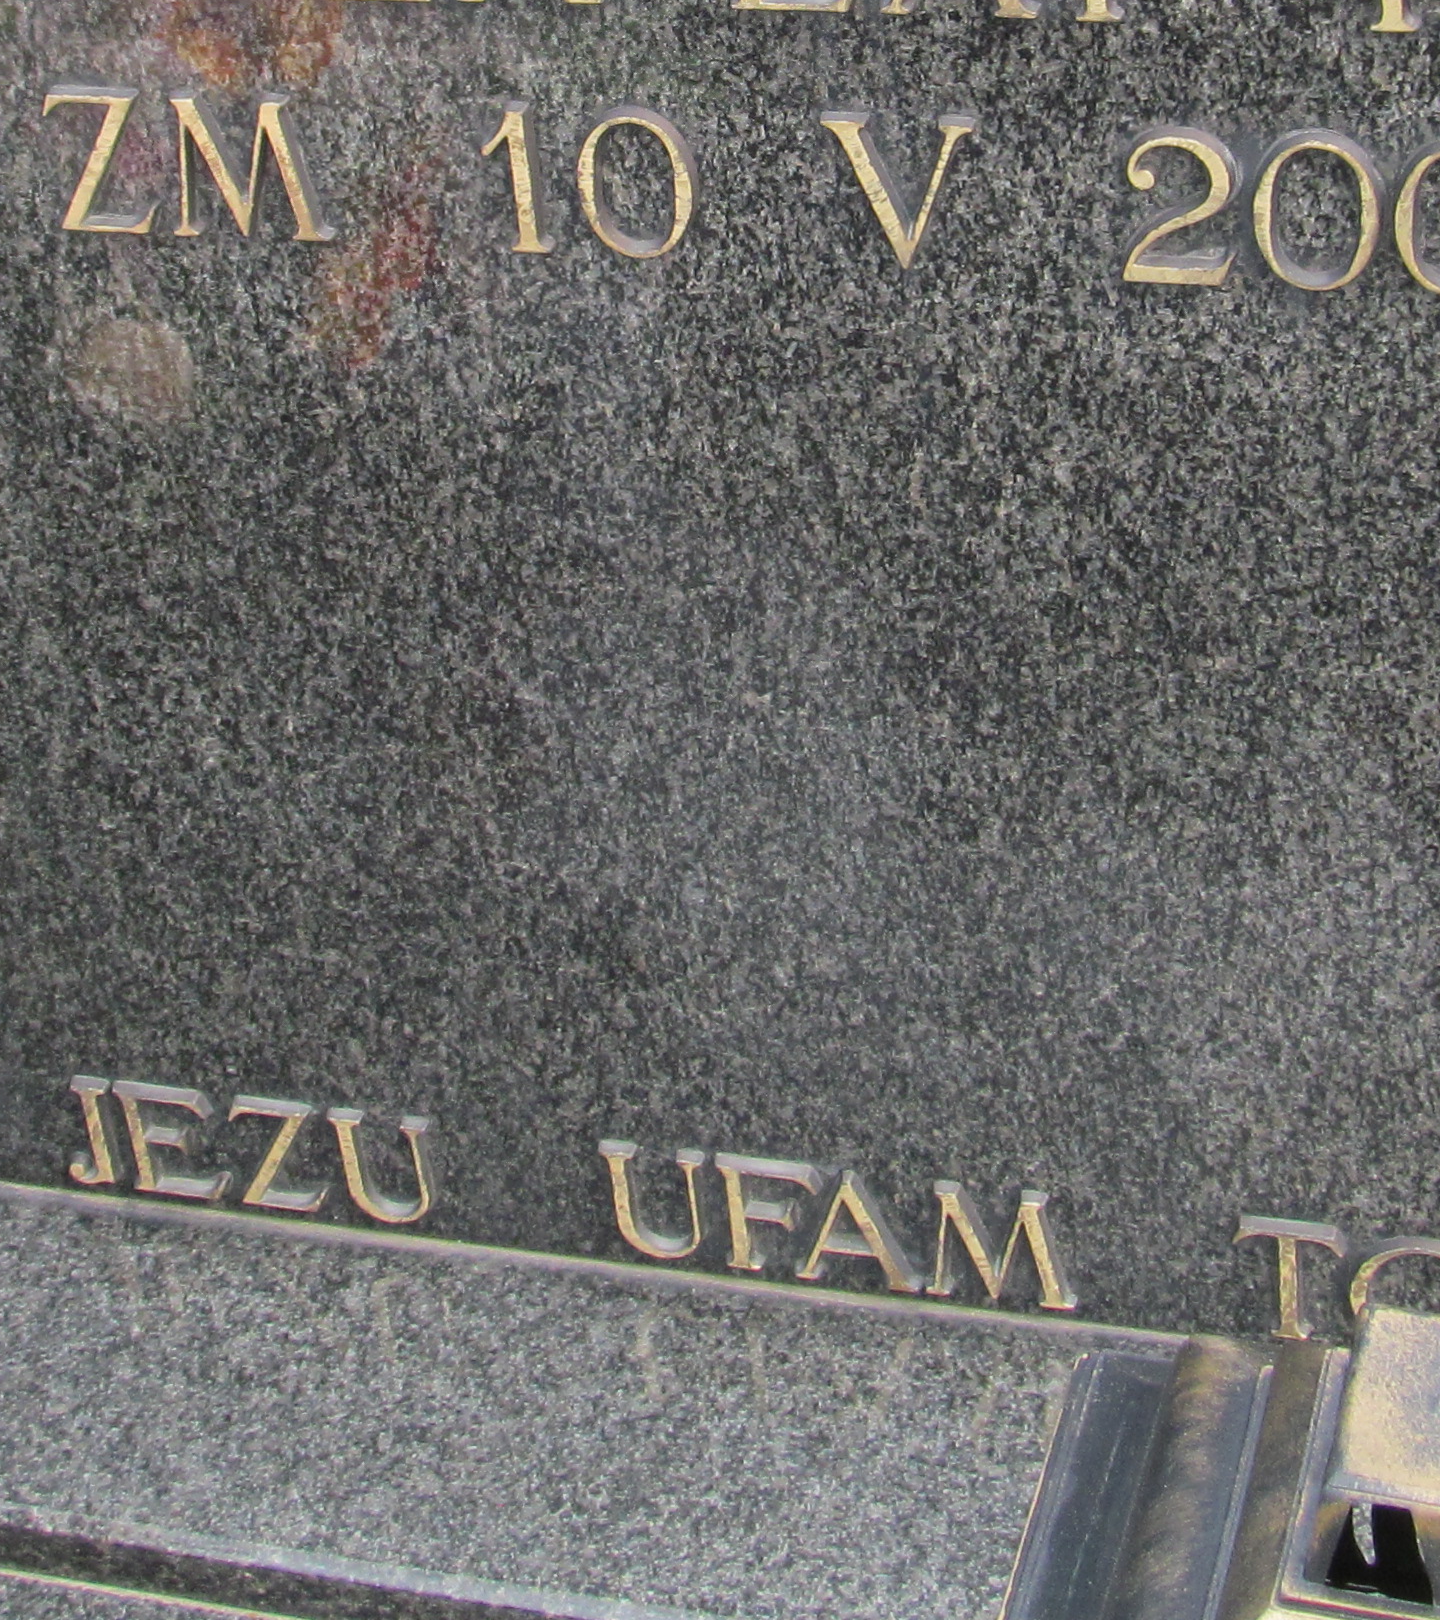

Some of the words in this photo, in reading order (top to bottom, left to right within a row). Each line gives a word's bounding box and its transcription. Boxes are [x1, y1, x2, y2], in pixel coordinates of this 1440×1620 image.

[42, 84, 337, 243] ZM
[481, 100, 700, 260] 10
[820, 110, 976, 269] V
[68, 1074, 433, 1225] JEZU
[597, 1138, 1079, 1312] UFAM
